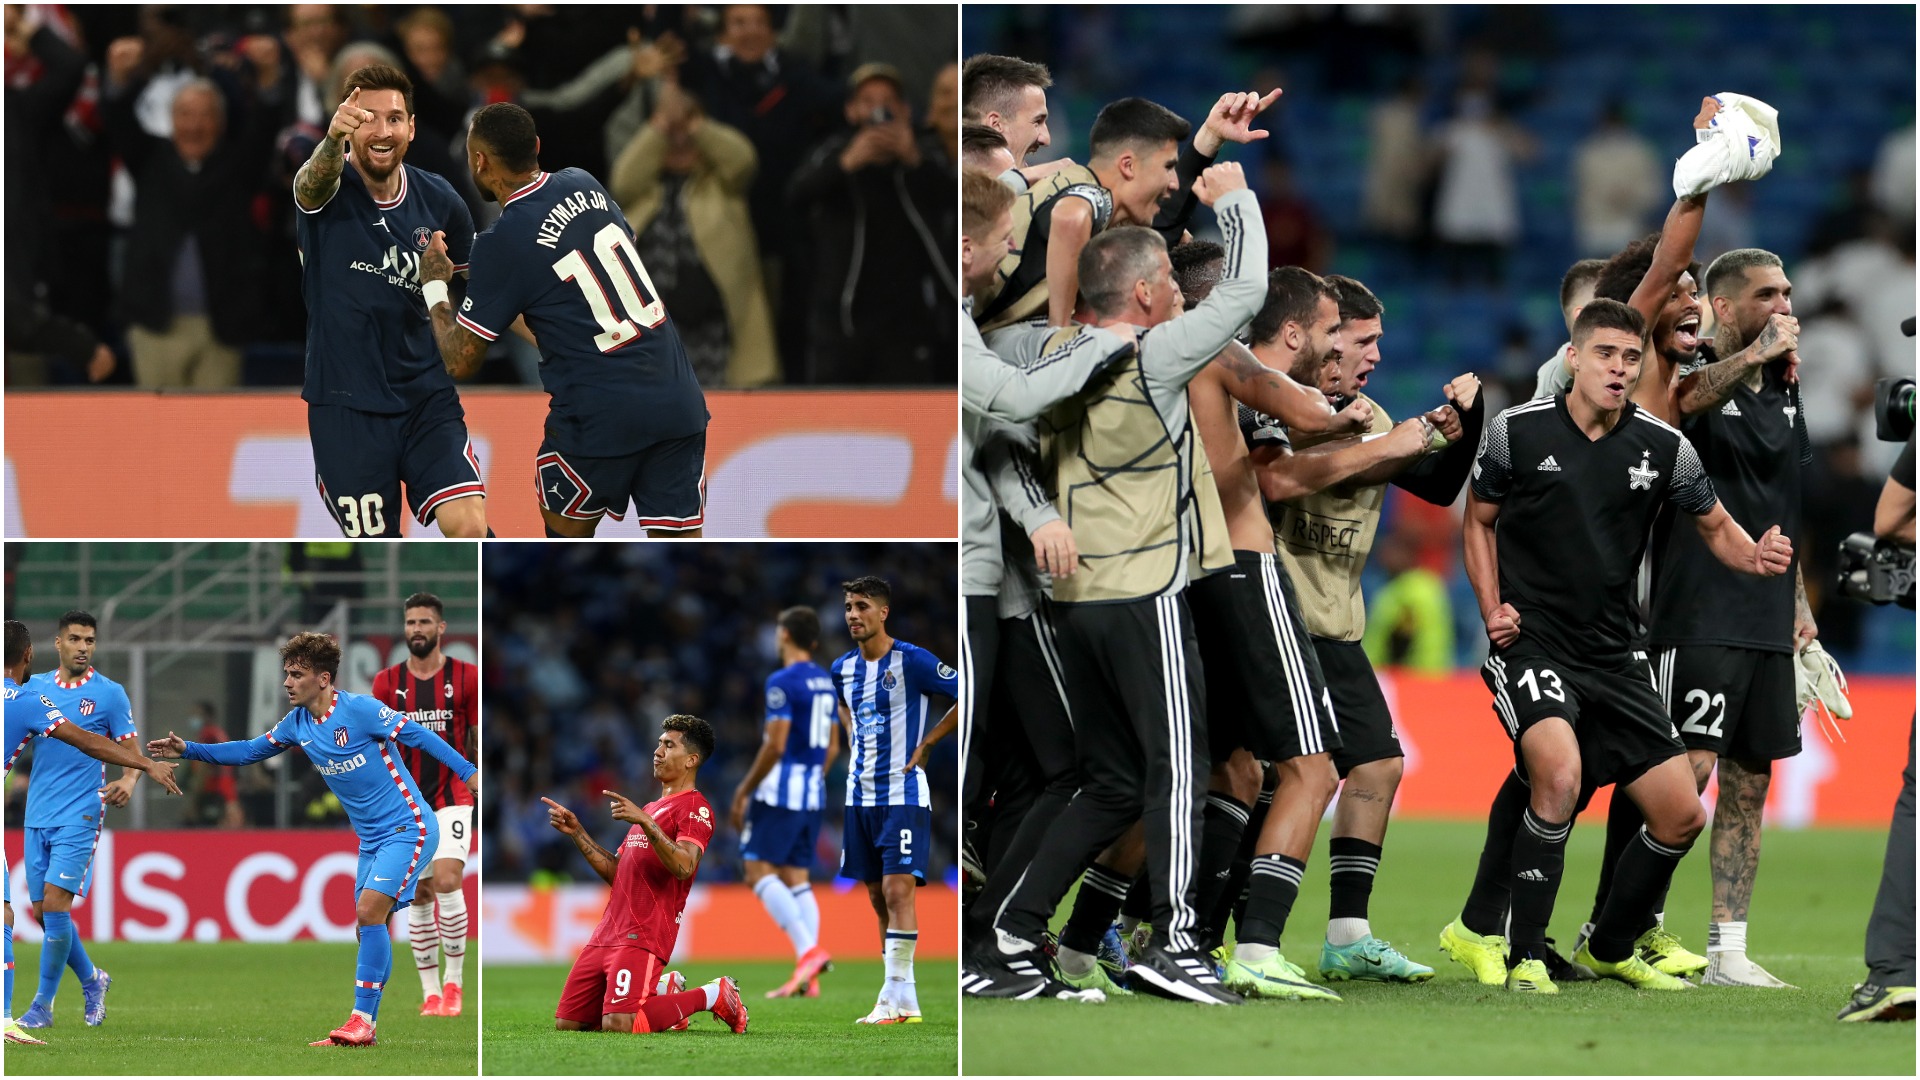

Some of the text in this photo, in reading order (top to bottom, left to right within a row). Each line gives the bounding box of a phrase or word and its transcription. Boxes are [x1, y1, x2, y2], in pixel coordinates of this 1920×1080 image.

[536, 190, 609, 249] NEYMAR JR
[349, 260, 386, 278] ACCO
[551, 222, 668, 353] 10
[1537, 464, 1562, 472] adidas
[337, 493, 386, 537] 30
[1517, 668, 1566, 703] 13
[1681, 688, 1727, 738] 22
[451, 820, 464, 839] 9
[900, 828, 912, 855] 2
[615, 969, 632, 997] 9
